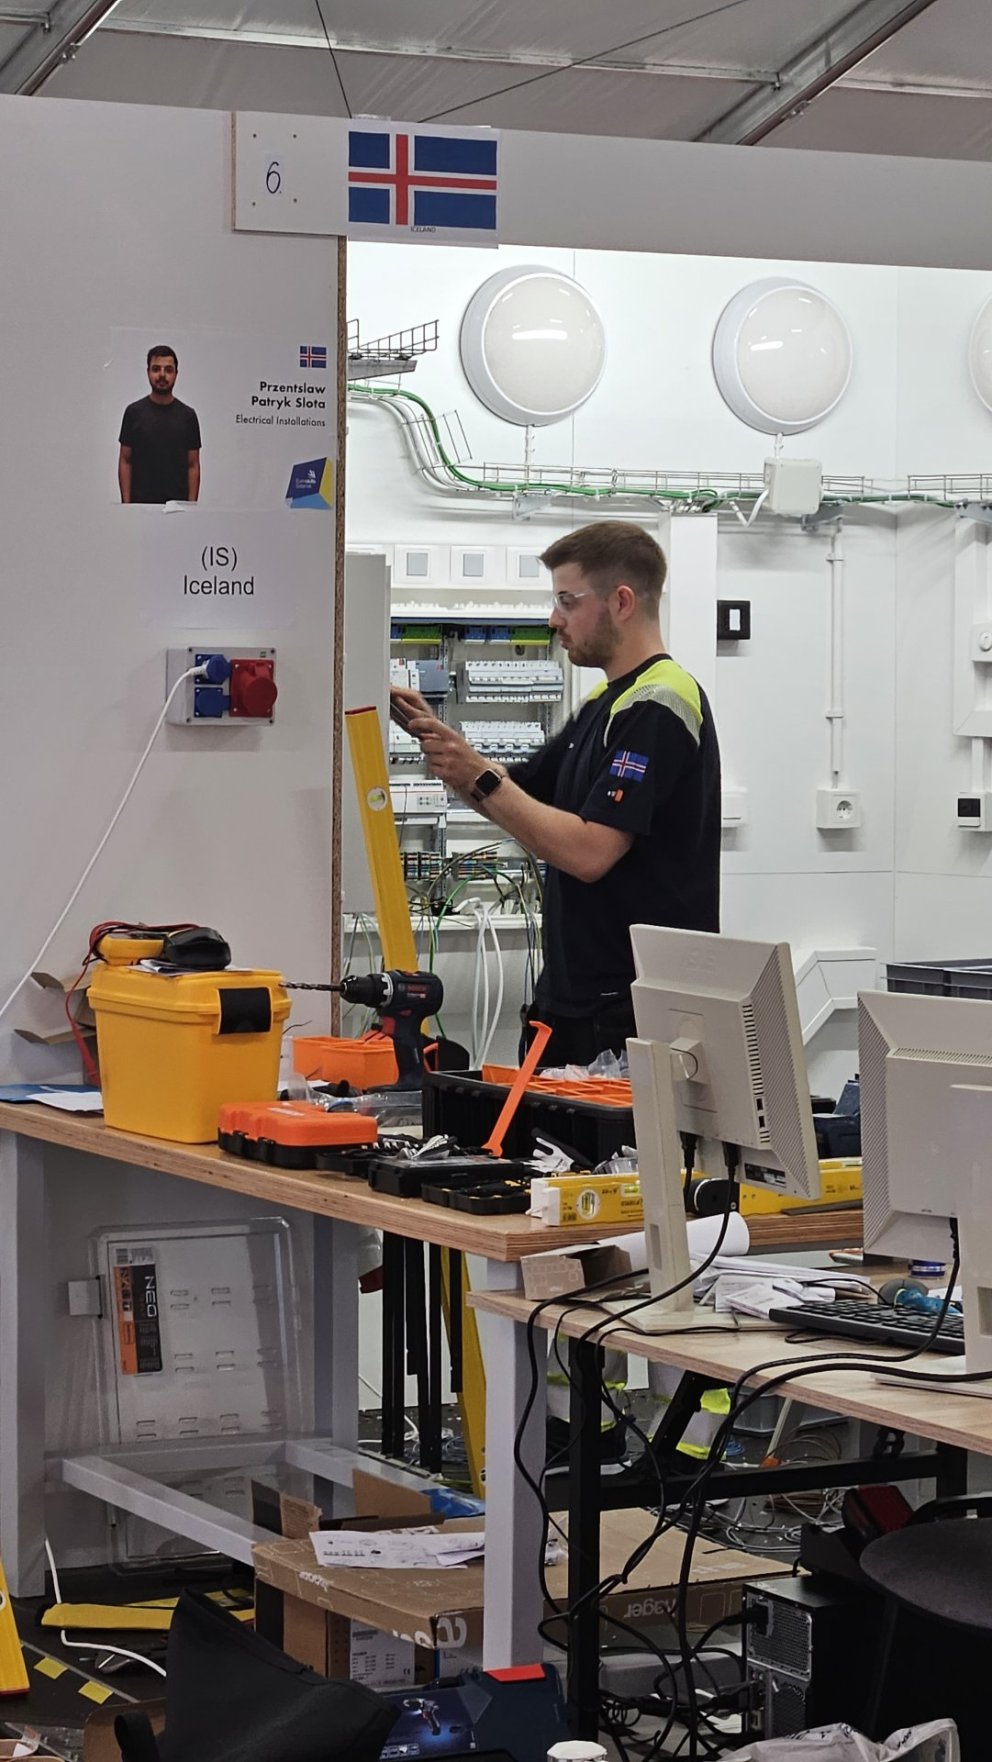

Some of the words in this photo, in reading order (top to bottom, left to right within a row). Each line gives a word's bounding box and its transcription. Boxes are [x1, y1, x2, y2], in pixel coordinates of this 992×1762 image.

[260, 381, 326, 394] Przentslaw
[251, 395, 291, 410] Patryk
[295, 397, 326, 409] Slota
[235, 414, 274, 425] Electrical
[276, 415, 326, 427] Installations
[201, 545, 238, 572] (IS)
[183, 574, 254, 596] Iceland
[144, 1276, 157, 1317] NEO
